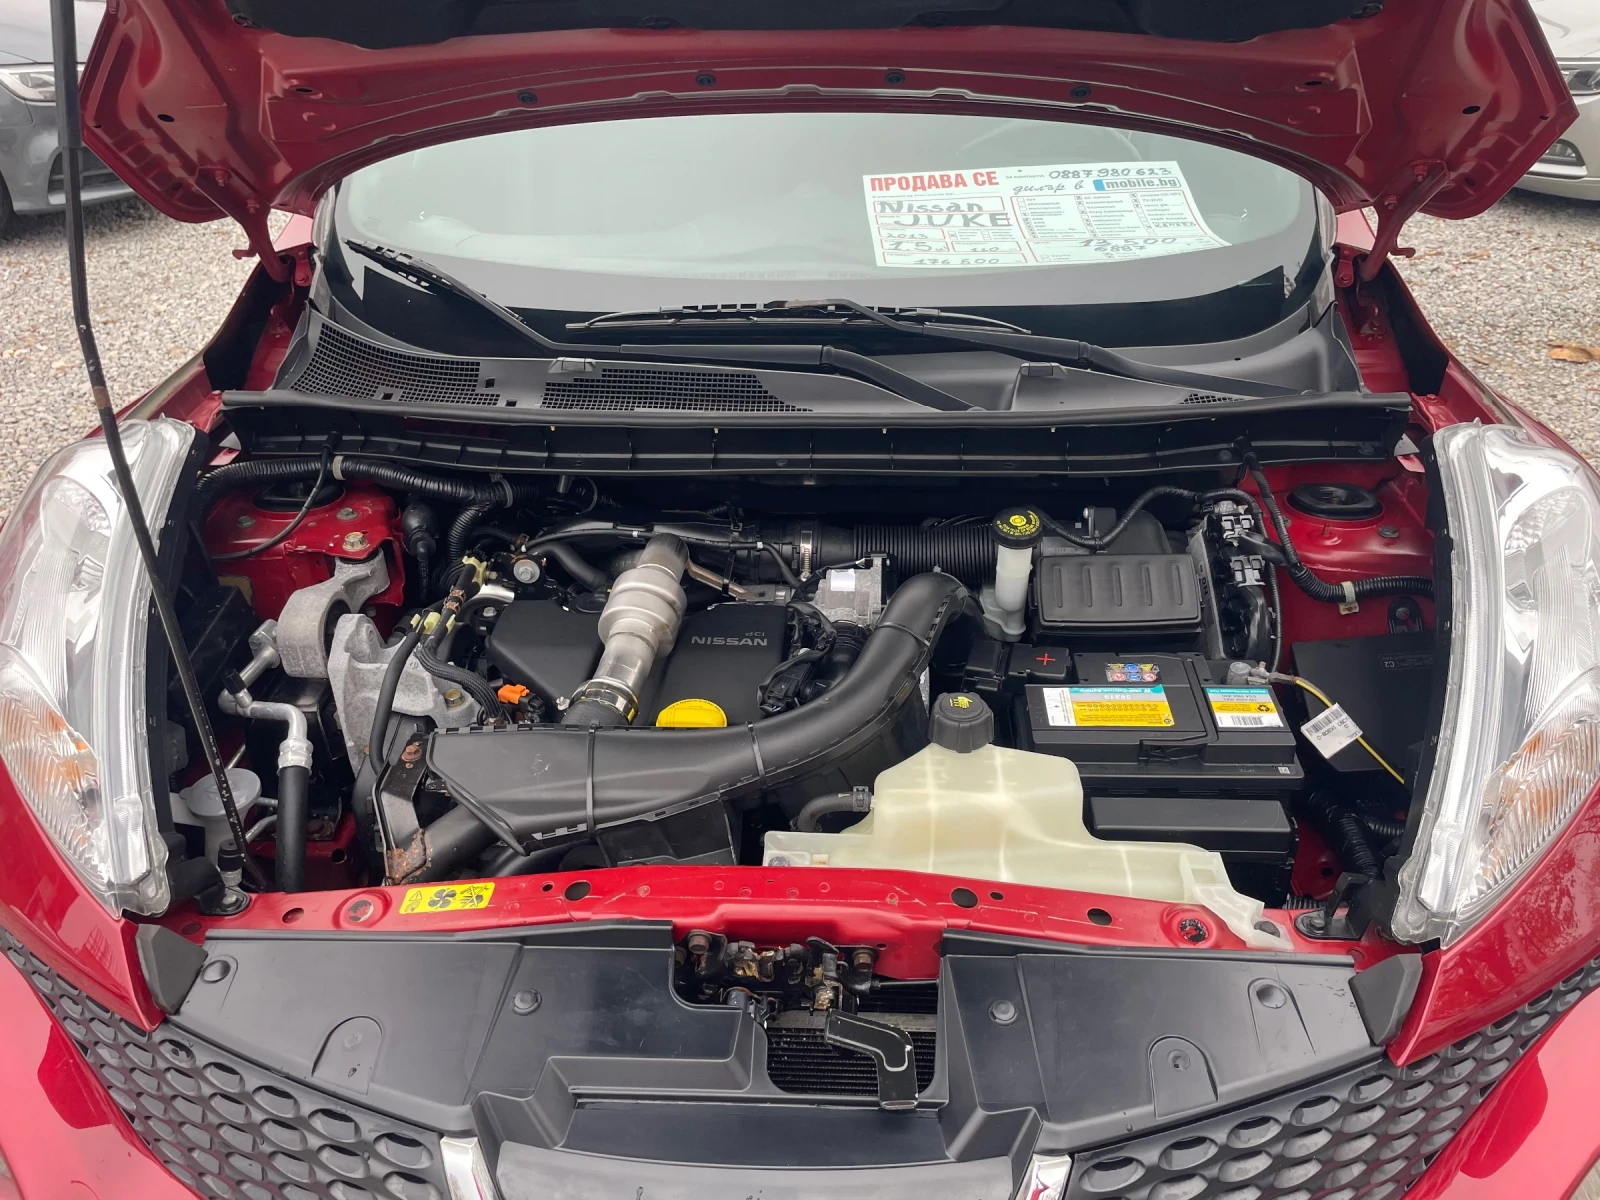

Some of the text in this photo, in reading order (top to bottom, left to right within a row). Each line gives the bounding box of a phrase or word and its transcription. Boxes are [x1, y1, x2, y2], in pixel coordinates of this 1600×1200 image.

[1048, 167, 1173, 179] 0887 980 623
[870, 170, 1000, 192] ПРОДАВА СЕ
[1105, 178, 1178, 189] mobile.bg
[880, 200, 984, 213] Nissan
[894, 212, 1013, 227] JUKE
[690, 636, 768, 646] NISSAN
